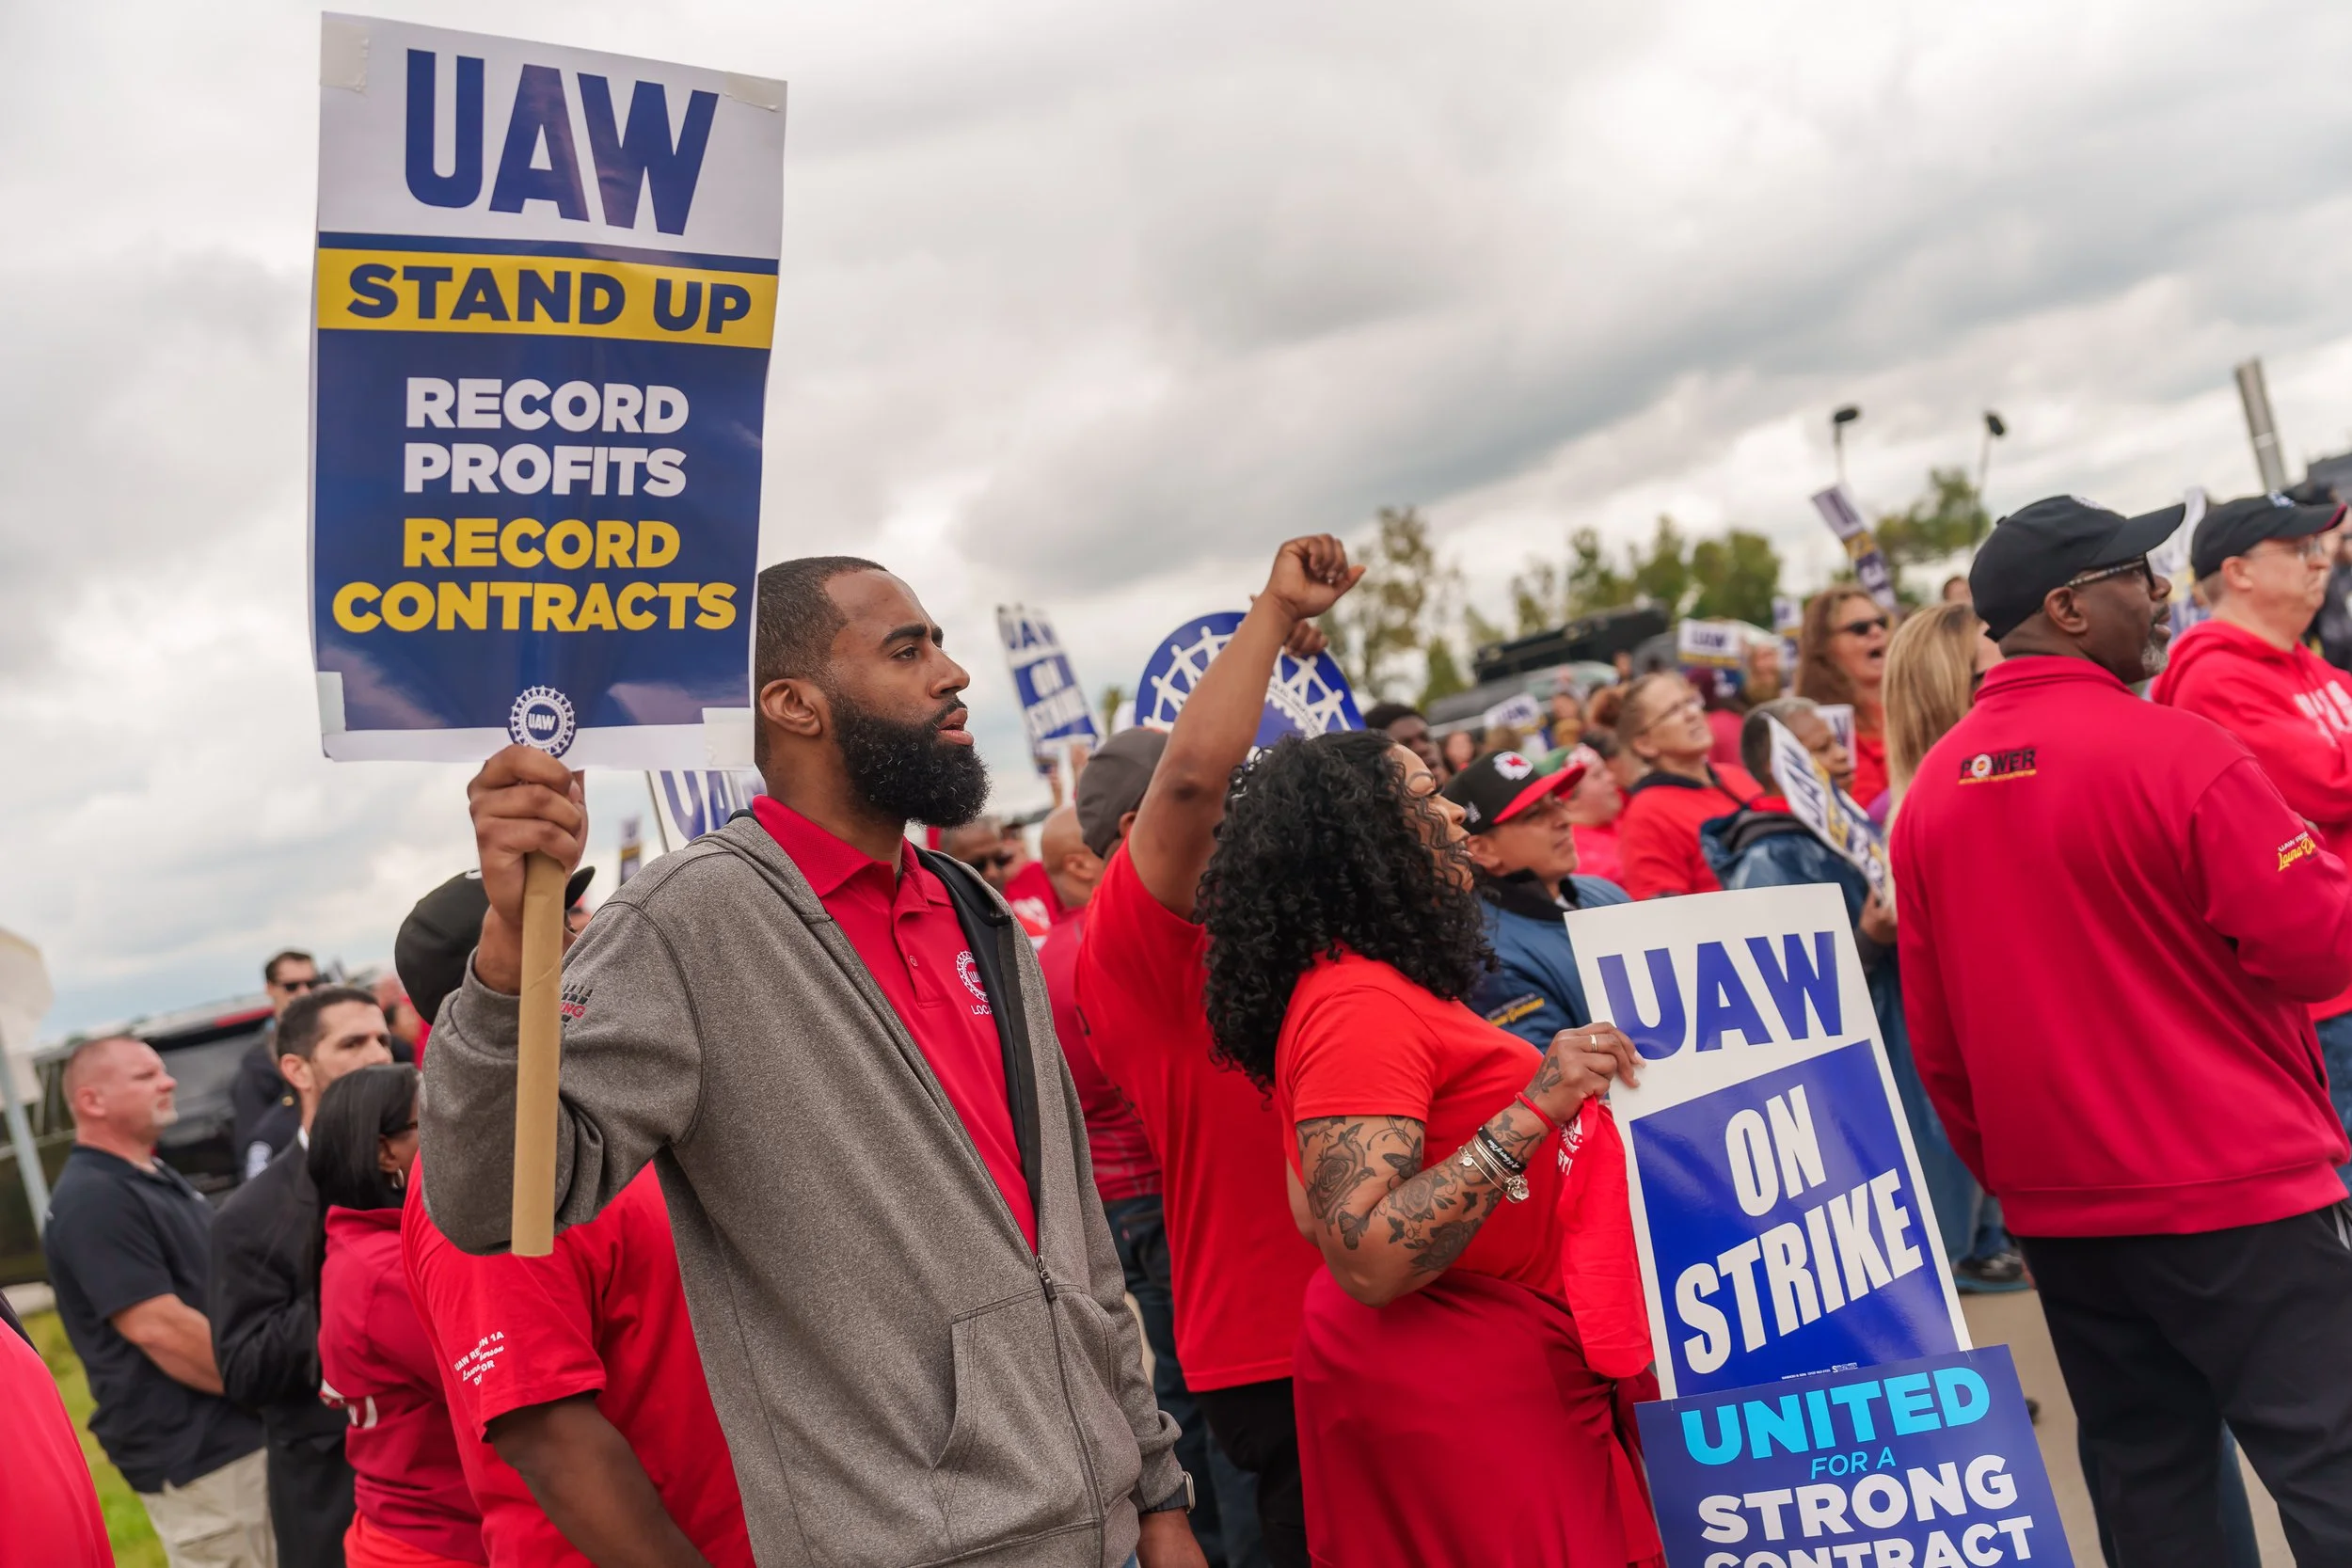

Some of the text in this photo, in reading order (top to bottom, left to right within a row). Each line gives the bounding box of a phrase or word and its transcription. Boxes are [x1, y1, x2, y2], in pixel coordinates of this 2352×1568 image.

[405, 48, 719, 235] UAW
[347, 263, 751, 333] STAND UP
[405, 376, 690, 434] RECORD
[404, 442, 687, 497] PROFITS
[403, 517, 680, 570] RECORD
[332, 581, 737, 633] CONTRACTS
[528, 713, 556, 731] UAW
[1960, 749, 2036, 779] POWER
[970, 1005, 992, 1015] LOC
[1597, 931, 1842, 1060] UAW
[1725, 1085, 1826, 1216] ON
[1676, 1168, 1924, 1374] STRIKE
[454, 1355, 469, 1370] UAW
[490, 1331, 504, 1341] 1A
[1680, 1367, 1991, 1465] UNITED
[1811, 1447, 1896, 1480] FOR A
[1698, 1454, 2018, 1544] STRONG
